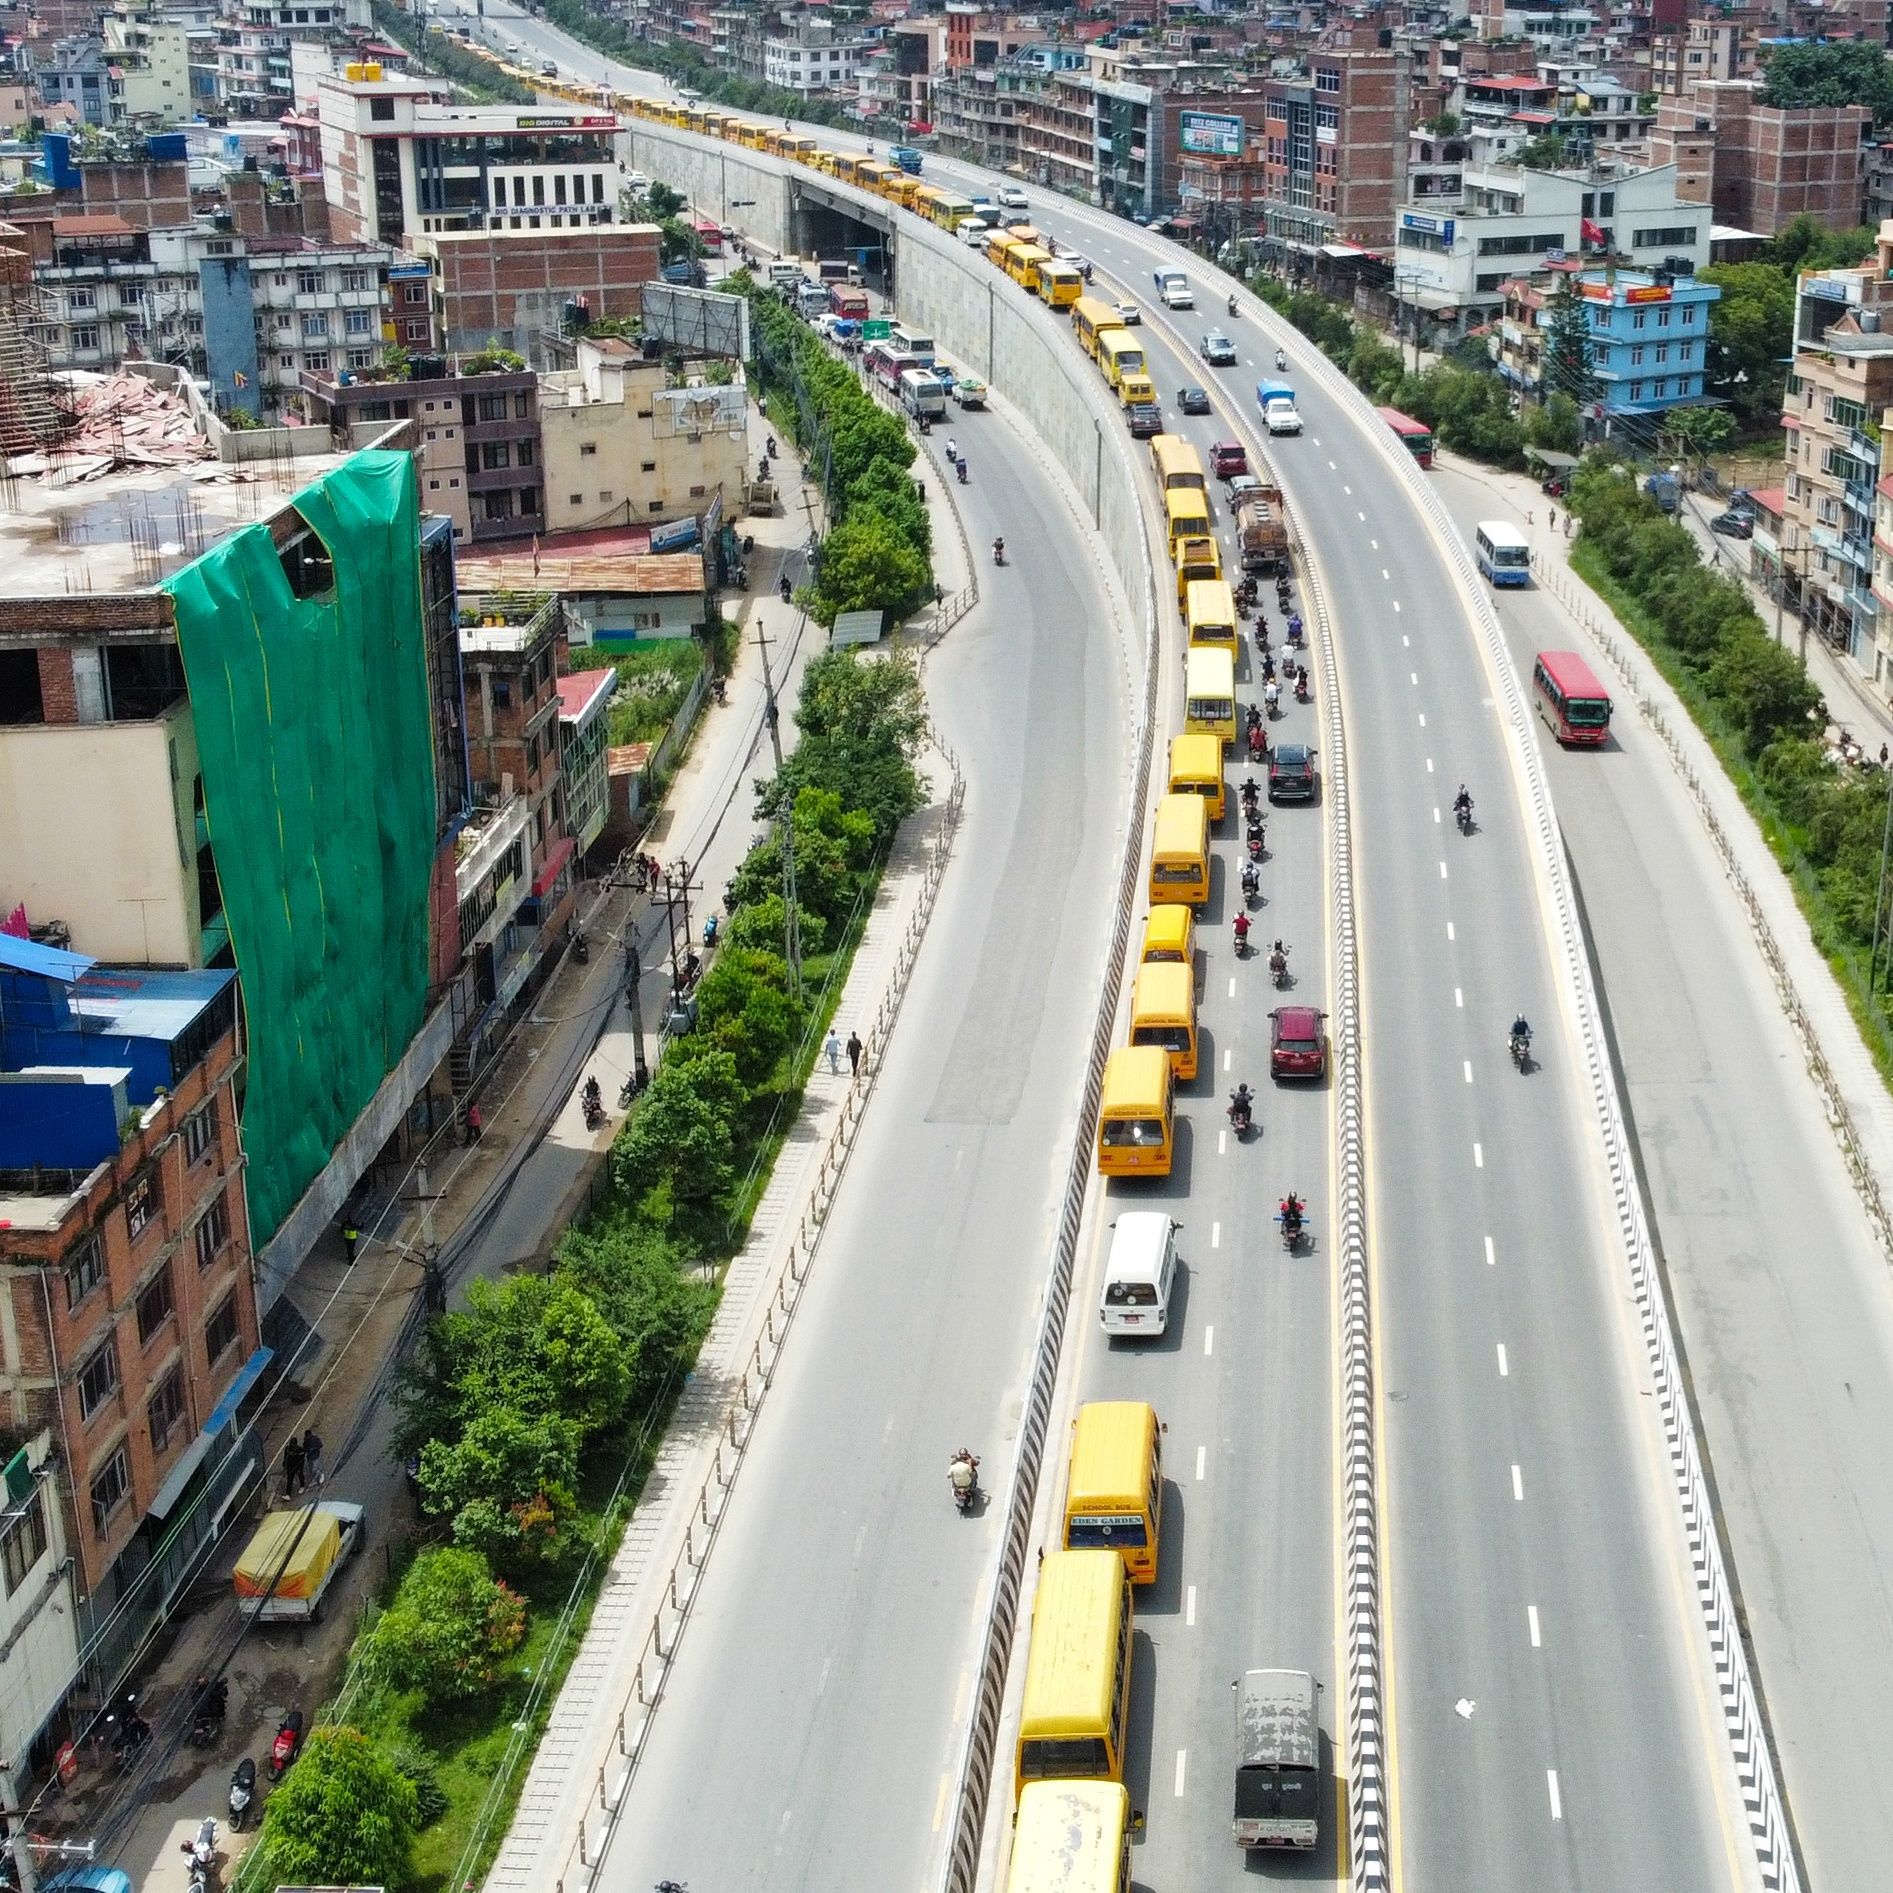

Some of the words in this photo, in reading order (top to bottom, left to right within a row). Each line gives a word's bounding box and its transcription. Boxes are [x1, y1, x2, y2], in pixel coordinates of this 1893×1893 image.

[495, 207, 508, 215] BIO
[511, 205, 556, 215] DIAGNOSTIC
[559, 204, 578, 213] PATH
[581, 203, 596, 212] LAB
